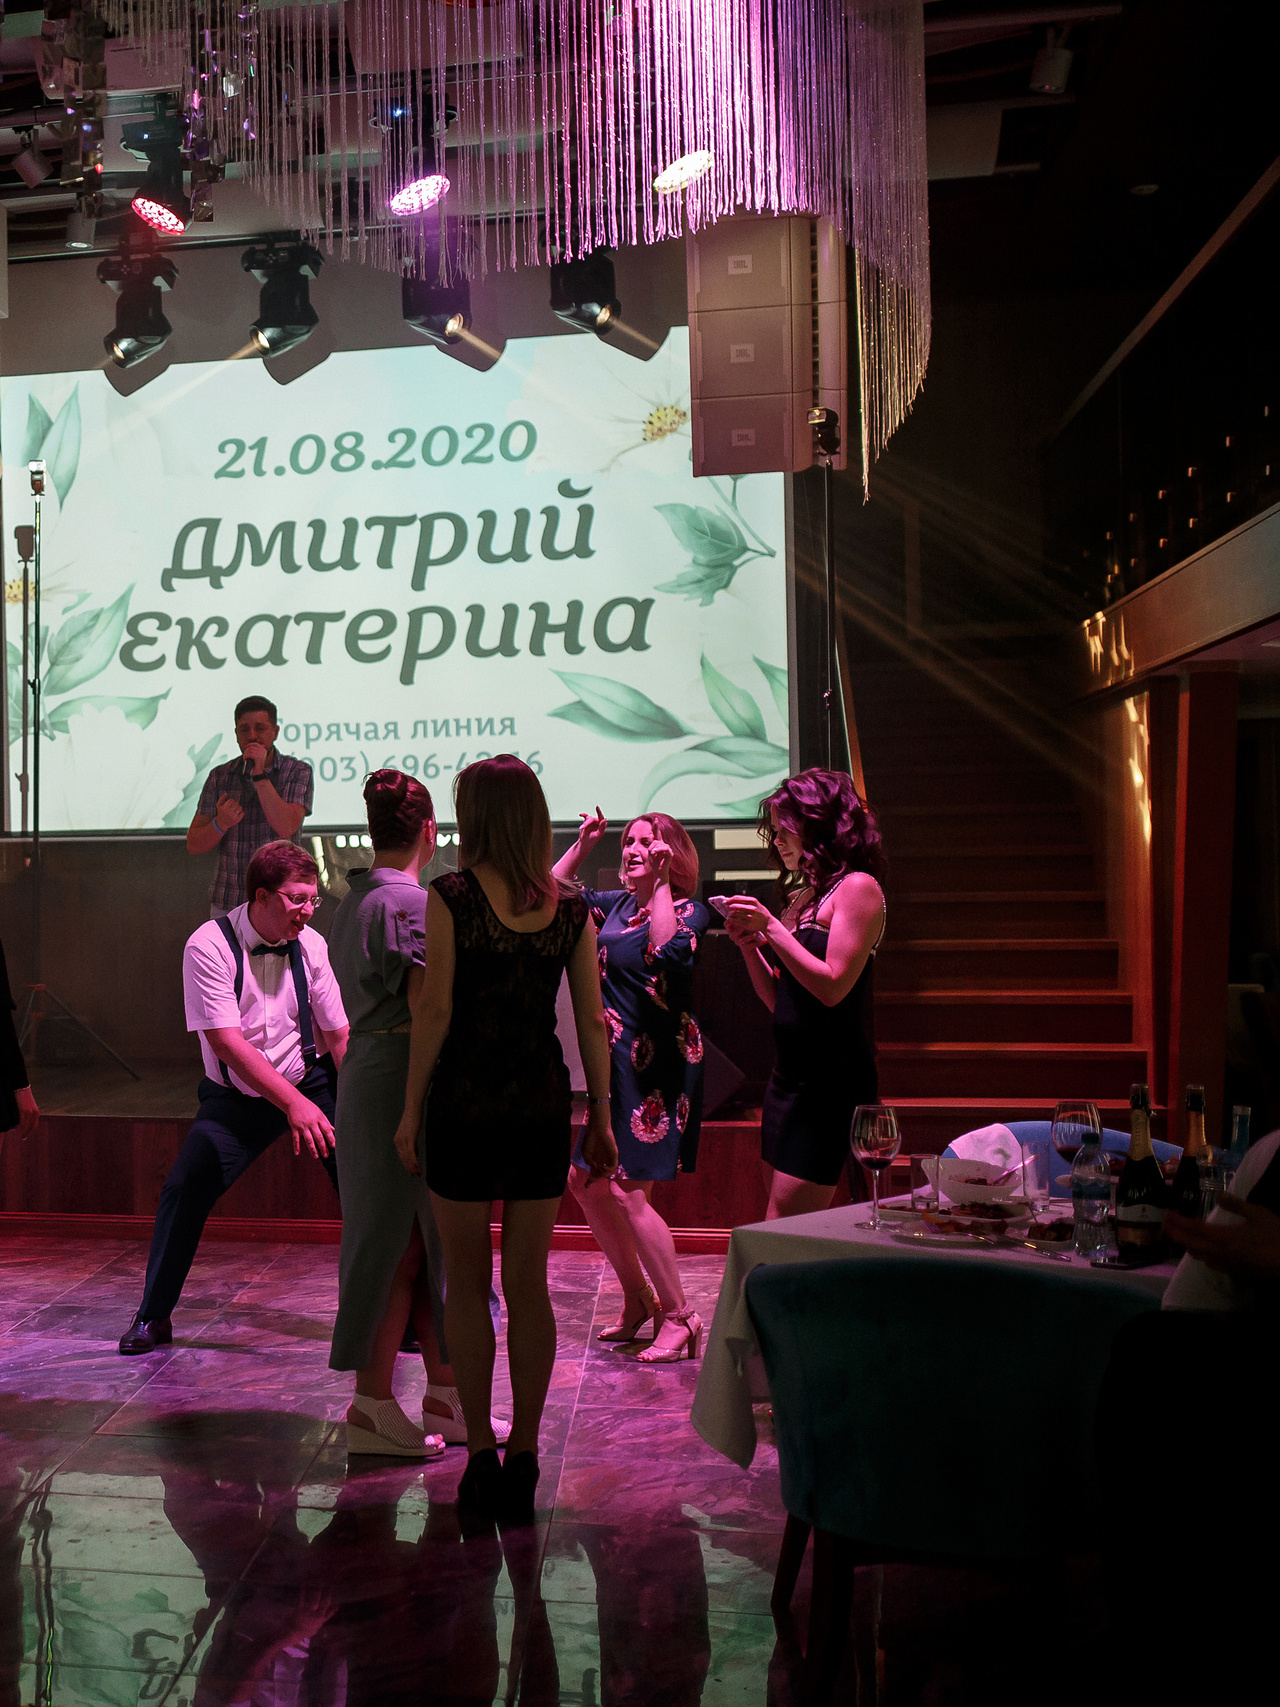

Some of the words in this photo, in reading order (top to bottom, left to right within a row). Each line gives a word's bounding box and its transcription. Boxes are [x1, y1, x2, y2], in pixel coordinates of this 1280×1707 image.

[213, 419, 538, 480] 21.08.2020
[160, 478, 596, 593] Дмитрий
[119, 595, 656, 686] Екатерина
[277, 717, 401, 750] орячая
[410, 716, 518, 740] линия
